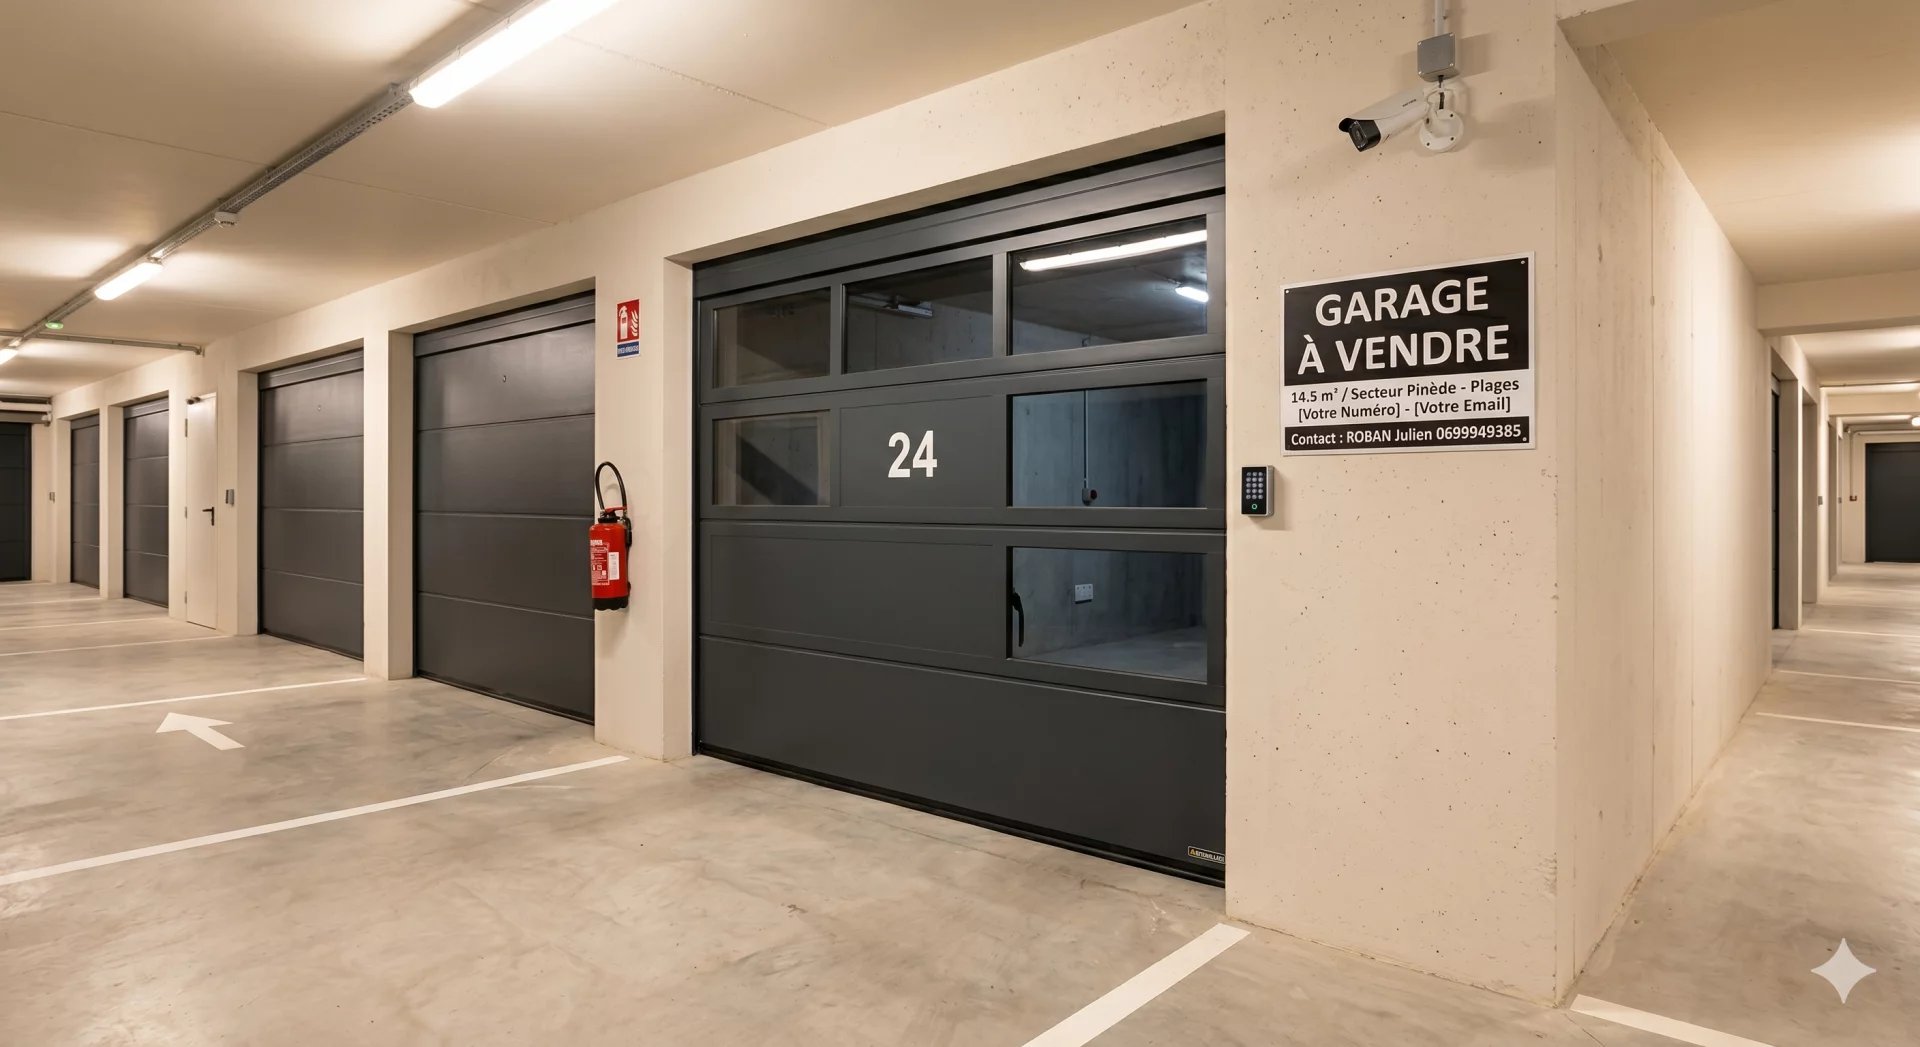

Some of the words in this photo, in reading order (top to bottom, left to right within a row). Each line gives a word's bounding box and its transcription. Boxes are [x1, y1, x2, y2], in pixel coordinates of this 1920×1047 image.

[1315, 275, 1489, 327] GARAGE
[1297, 334, 1325, 375] À
[1335, 324, 1510, 372] VENDRE
[1291, 390, 1318, 404] 14.5
[1321, 387, 1339, 402] m²
[1341, 387, 1348, 403] /
[1351, 386, 1404, 401] Secteur
[1407, 381, 1457, 397] Pinède
[1471, 379, 1520, 395] Plages
[1298, 407, 1337, 423] [Votre
[1341, 402, 1400, 419] Numéro]
[1414, 401, 1460, 418] [Votre
[1464, 396, 1511, 414] Email]
[1291, 432, 1337, 446] Contact
[1346, 428, 1392, 444] ROBAN
[1394, 428, 1433, 442] Julien
[1436, 424, 1522, 441] 0699949385
[887, 430, 938, 478] 24
